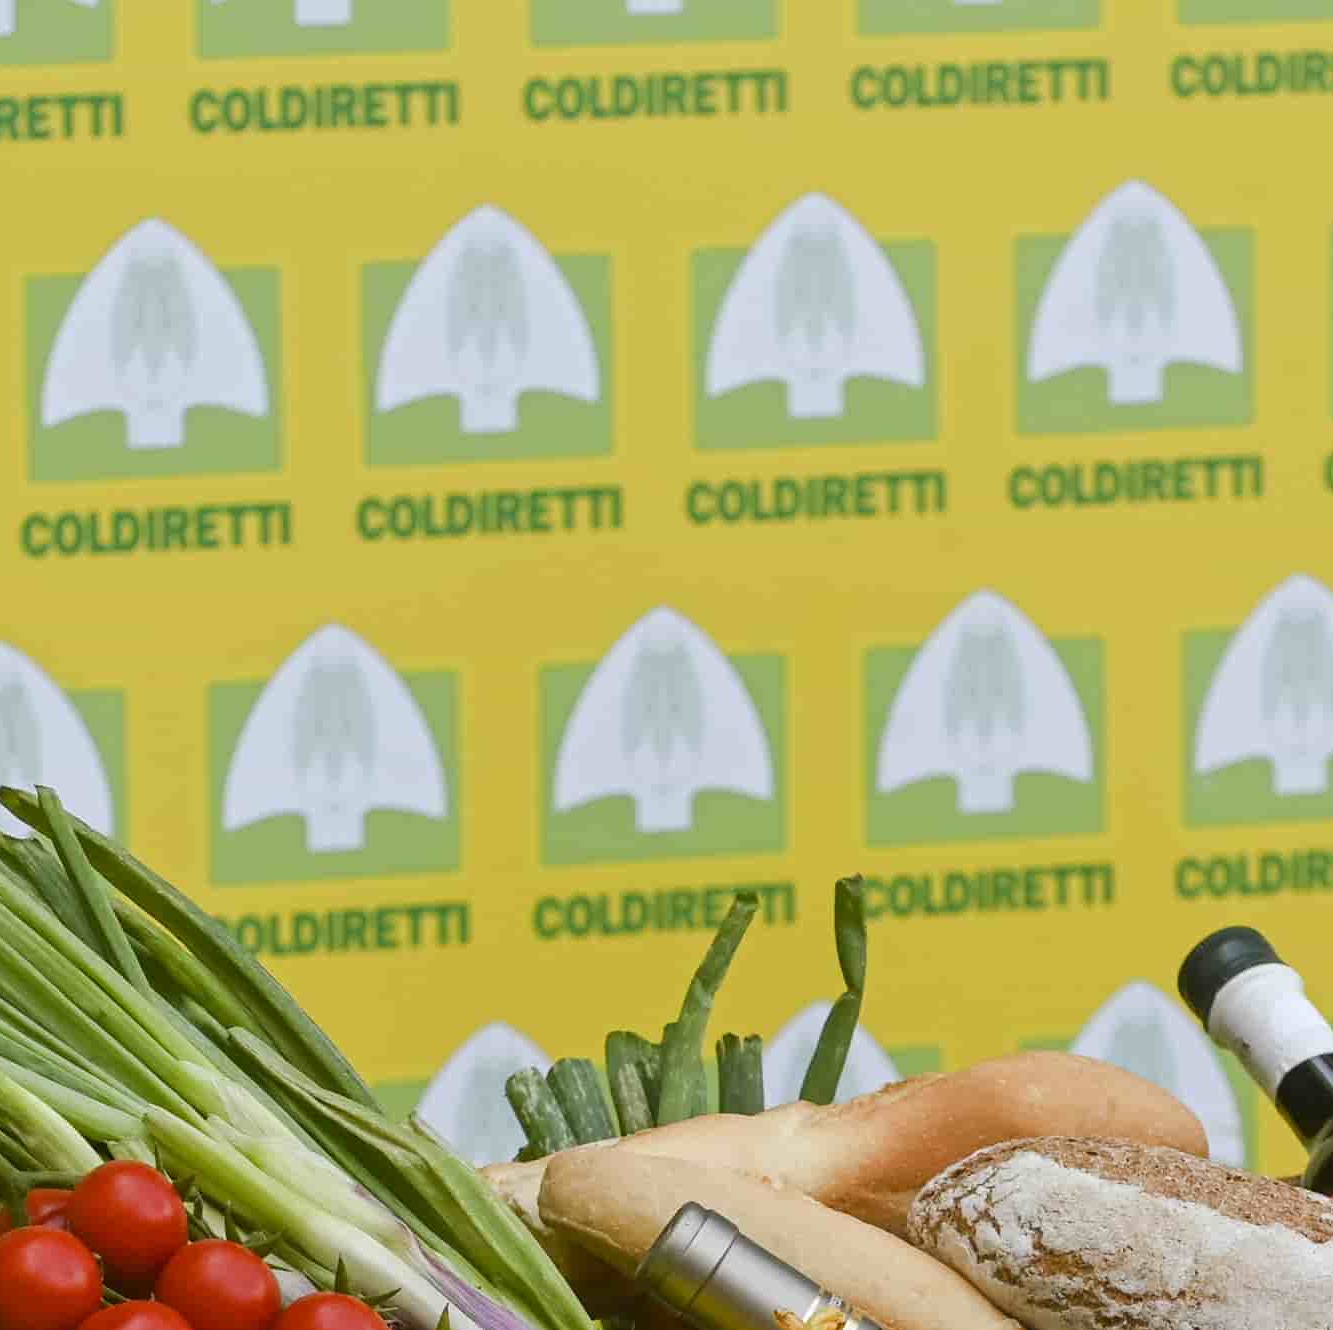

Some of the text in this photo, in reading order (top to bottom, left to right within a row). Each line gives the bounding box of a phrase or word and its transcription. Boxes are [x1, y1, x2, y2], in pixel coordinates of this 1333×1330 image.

[191, 84, 459, 134] COLDIRETTI
[525, 72, 787, 121] COLDIRETTI
[853, 61, 1108, 108] COLDIRETTI
[688, 473, 946, 524] COLDIRETTI
[1011, 458, 1262, 508] COLDIRETTI
[23, 504, 292, 557] COLDIRETTI
[359, 488, 623, 540] COLDIRETTI
[865, 863, 1114, 920] COLDIRETTI
[233, 904, 471, 956] OLDIRETTI
